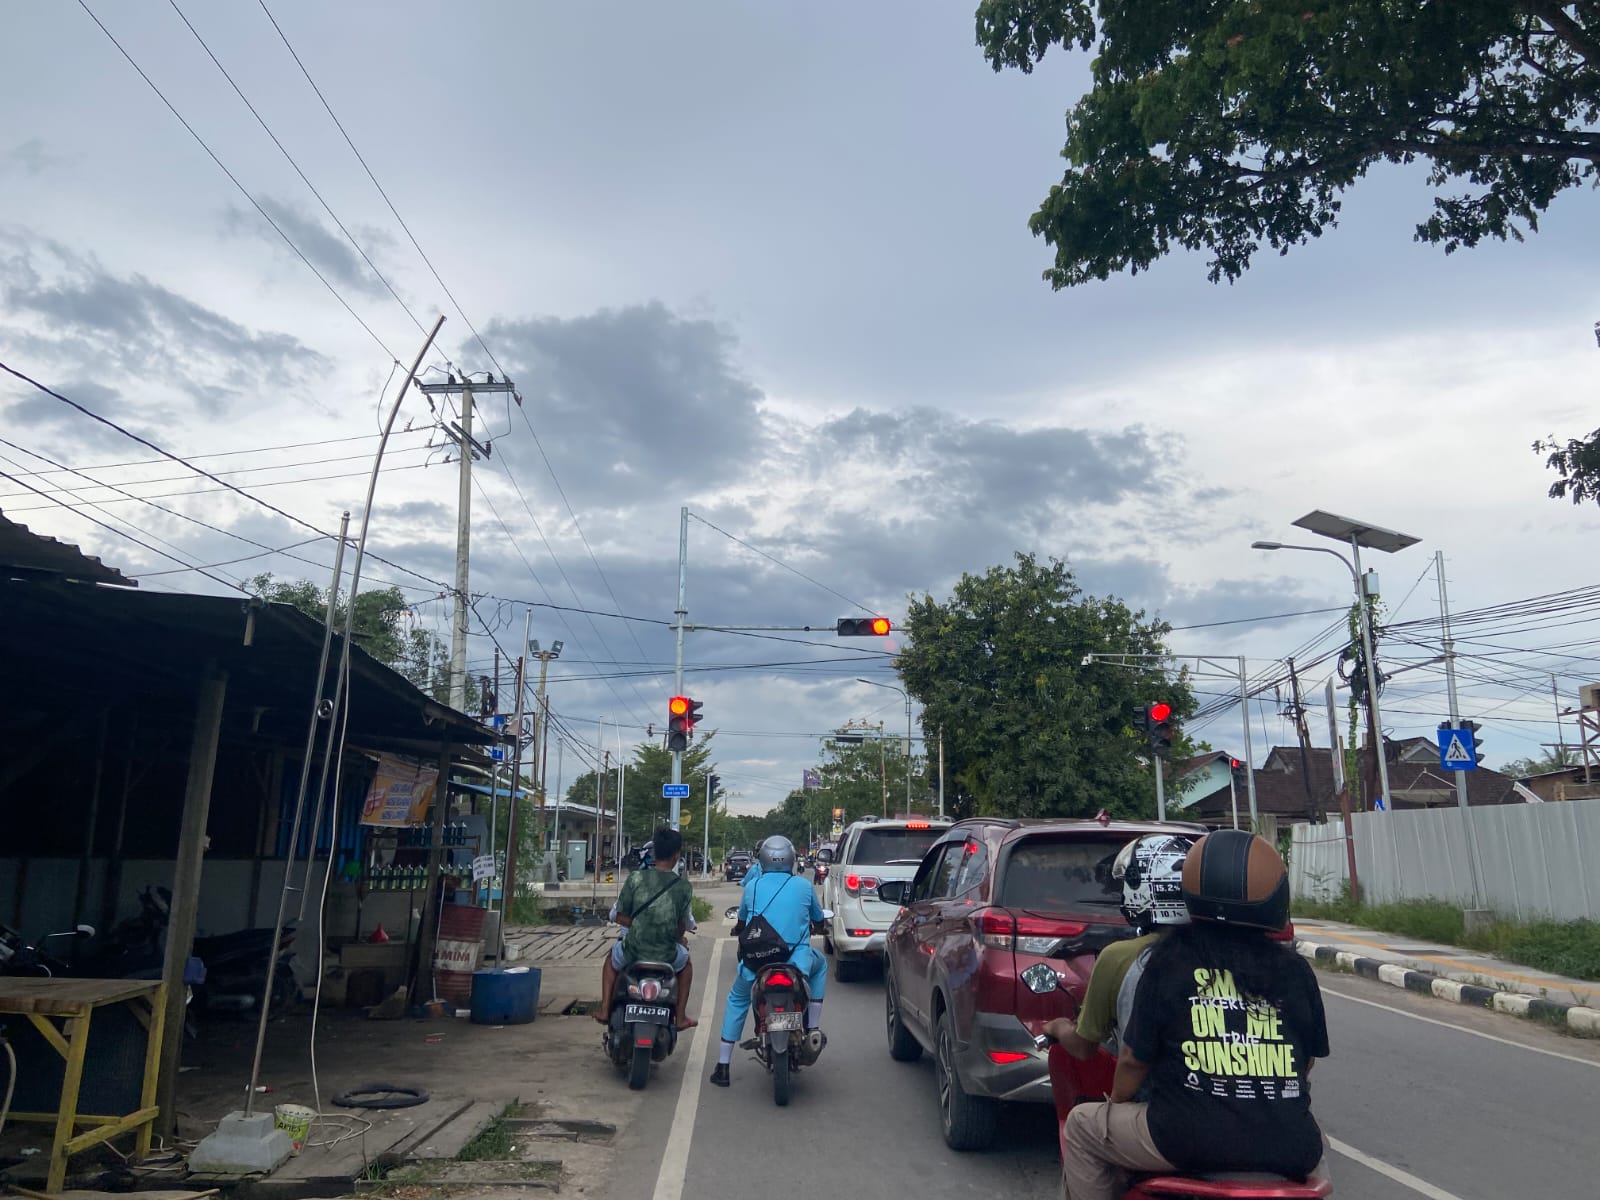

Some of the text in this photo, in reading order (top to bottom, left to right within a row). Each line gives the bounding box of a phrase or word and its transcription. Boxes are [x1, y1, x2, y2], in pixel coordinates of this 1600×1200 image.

[433, 950, 471, 962] MINA
[1190, 1003, 1284, 1041] ON ME
[1181, 1040, 1298, 1078] SUNSHINE
